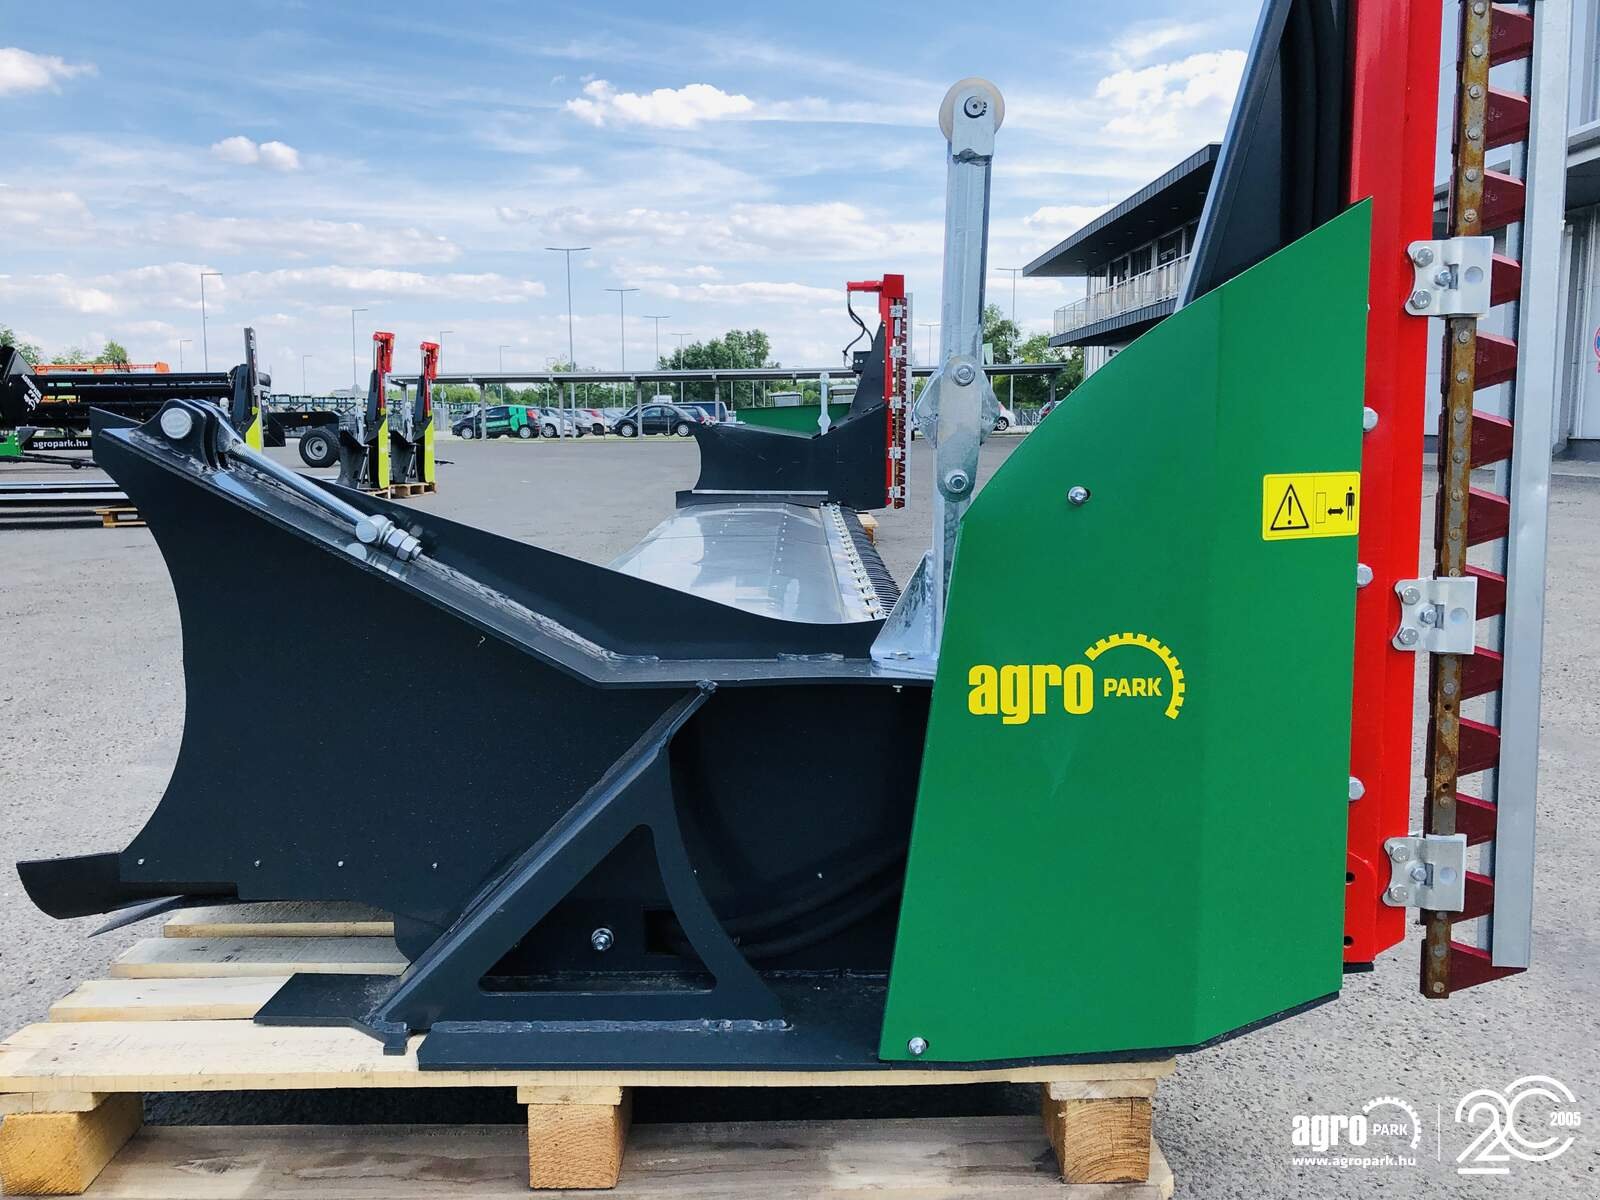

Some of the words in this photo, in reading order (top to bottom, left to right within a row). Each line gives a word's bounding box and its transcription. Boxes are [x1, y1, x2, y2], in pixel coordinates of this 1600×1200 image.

[33, 438, 88, 449] agropark.hu
[968, 663, 1094, 725] agro
[1103, 677, 1163, 697] PARK
